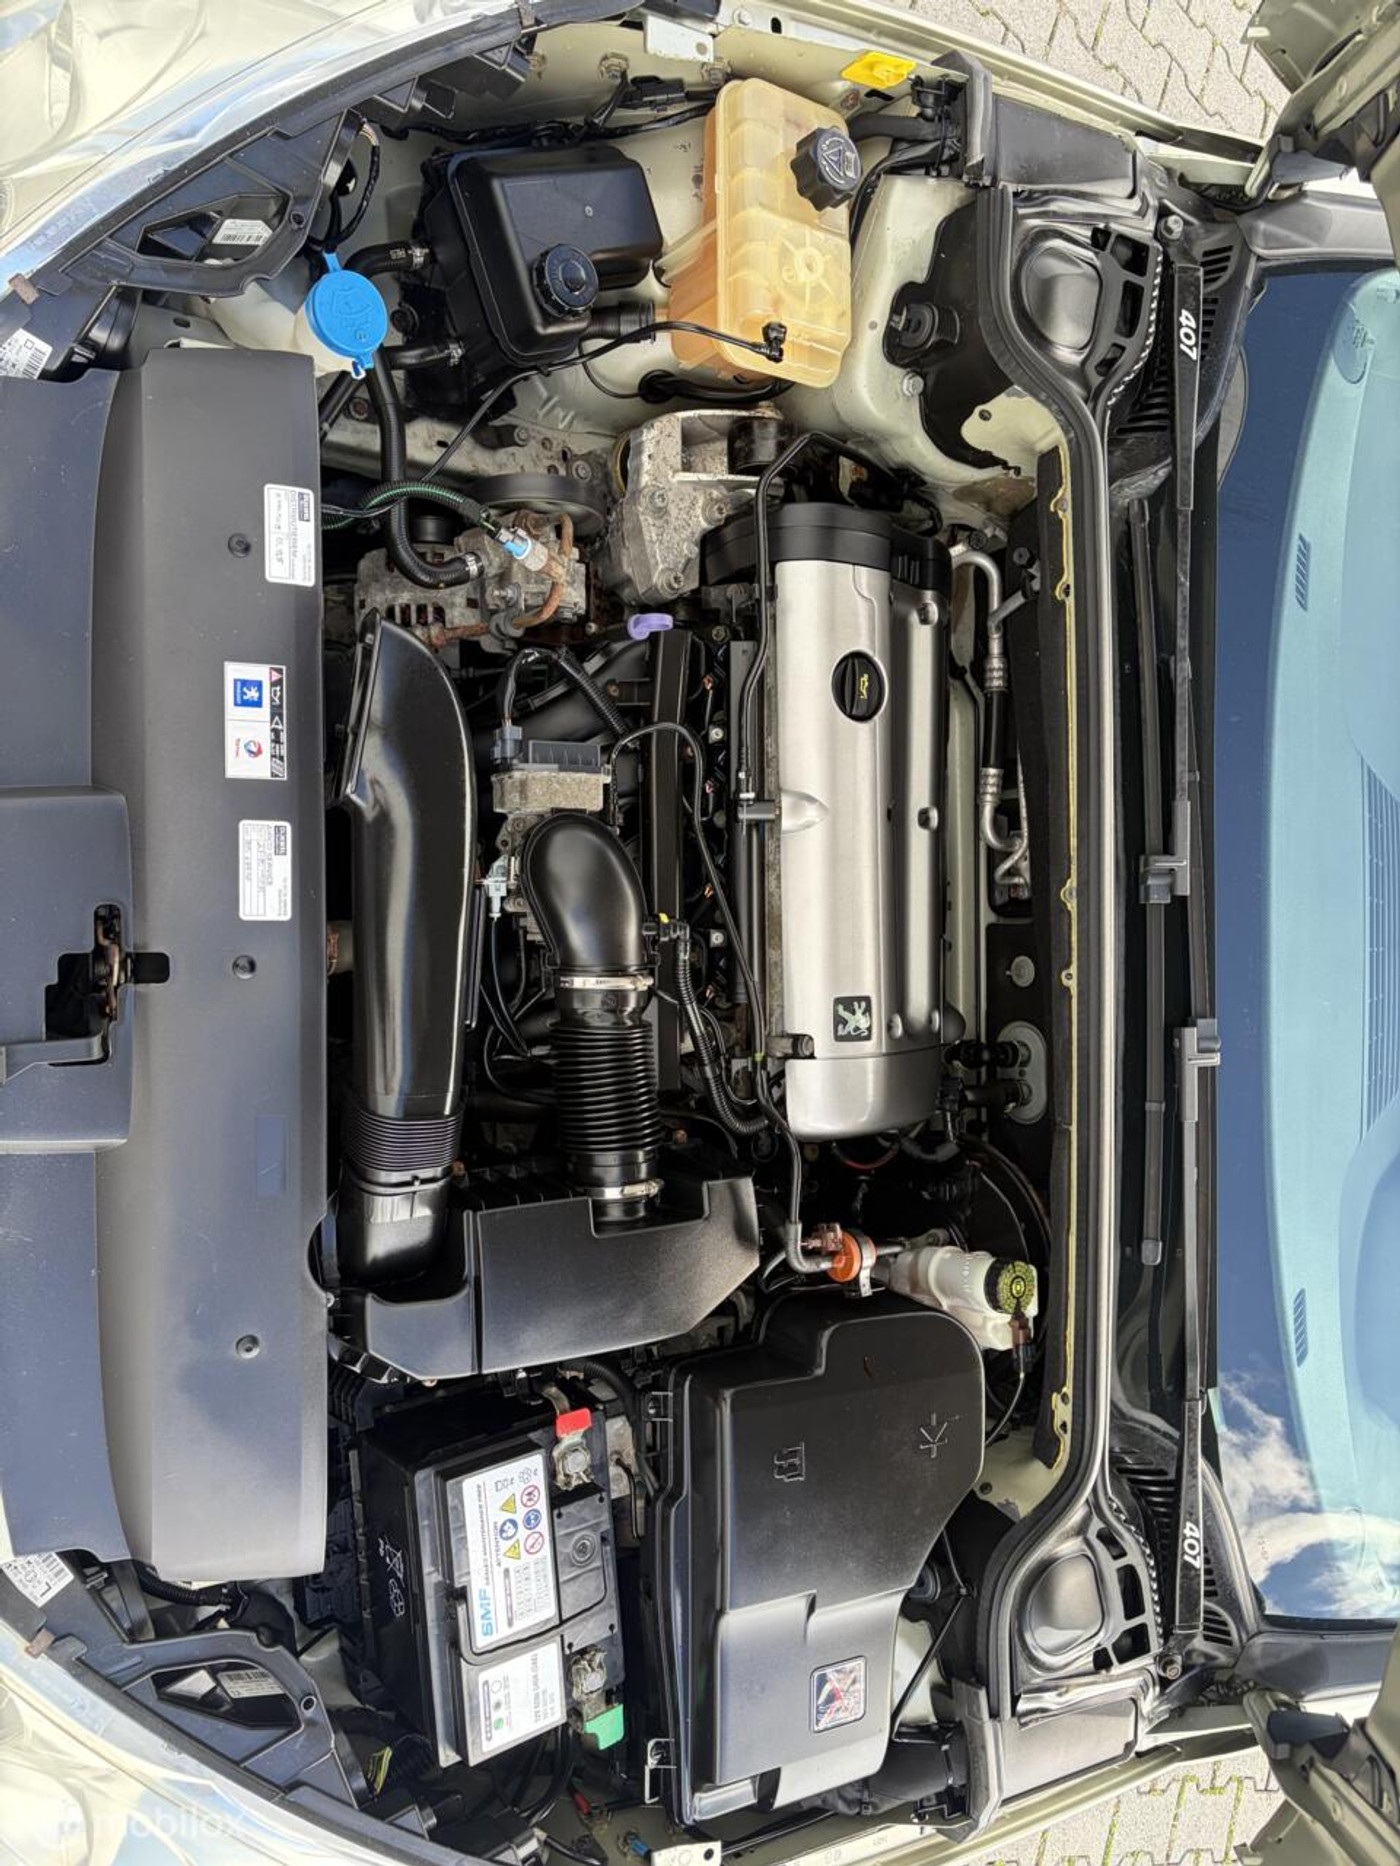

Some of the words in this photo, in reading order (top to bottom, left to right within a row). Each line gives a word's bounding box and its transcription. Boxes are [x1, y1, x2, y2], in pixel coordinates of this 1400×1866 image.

[1179, 308, 1197, 360] 407
[1183, 1521, 1200, 1569] 407
[479, 1588, 493, 1636] SMF
